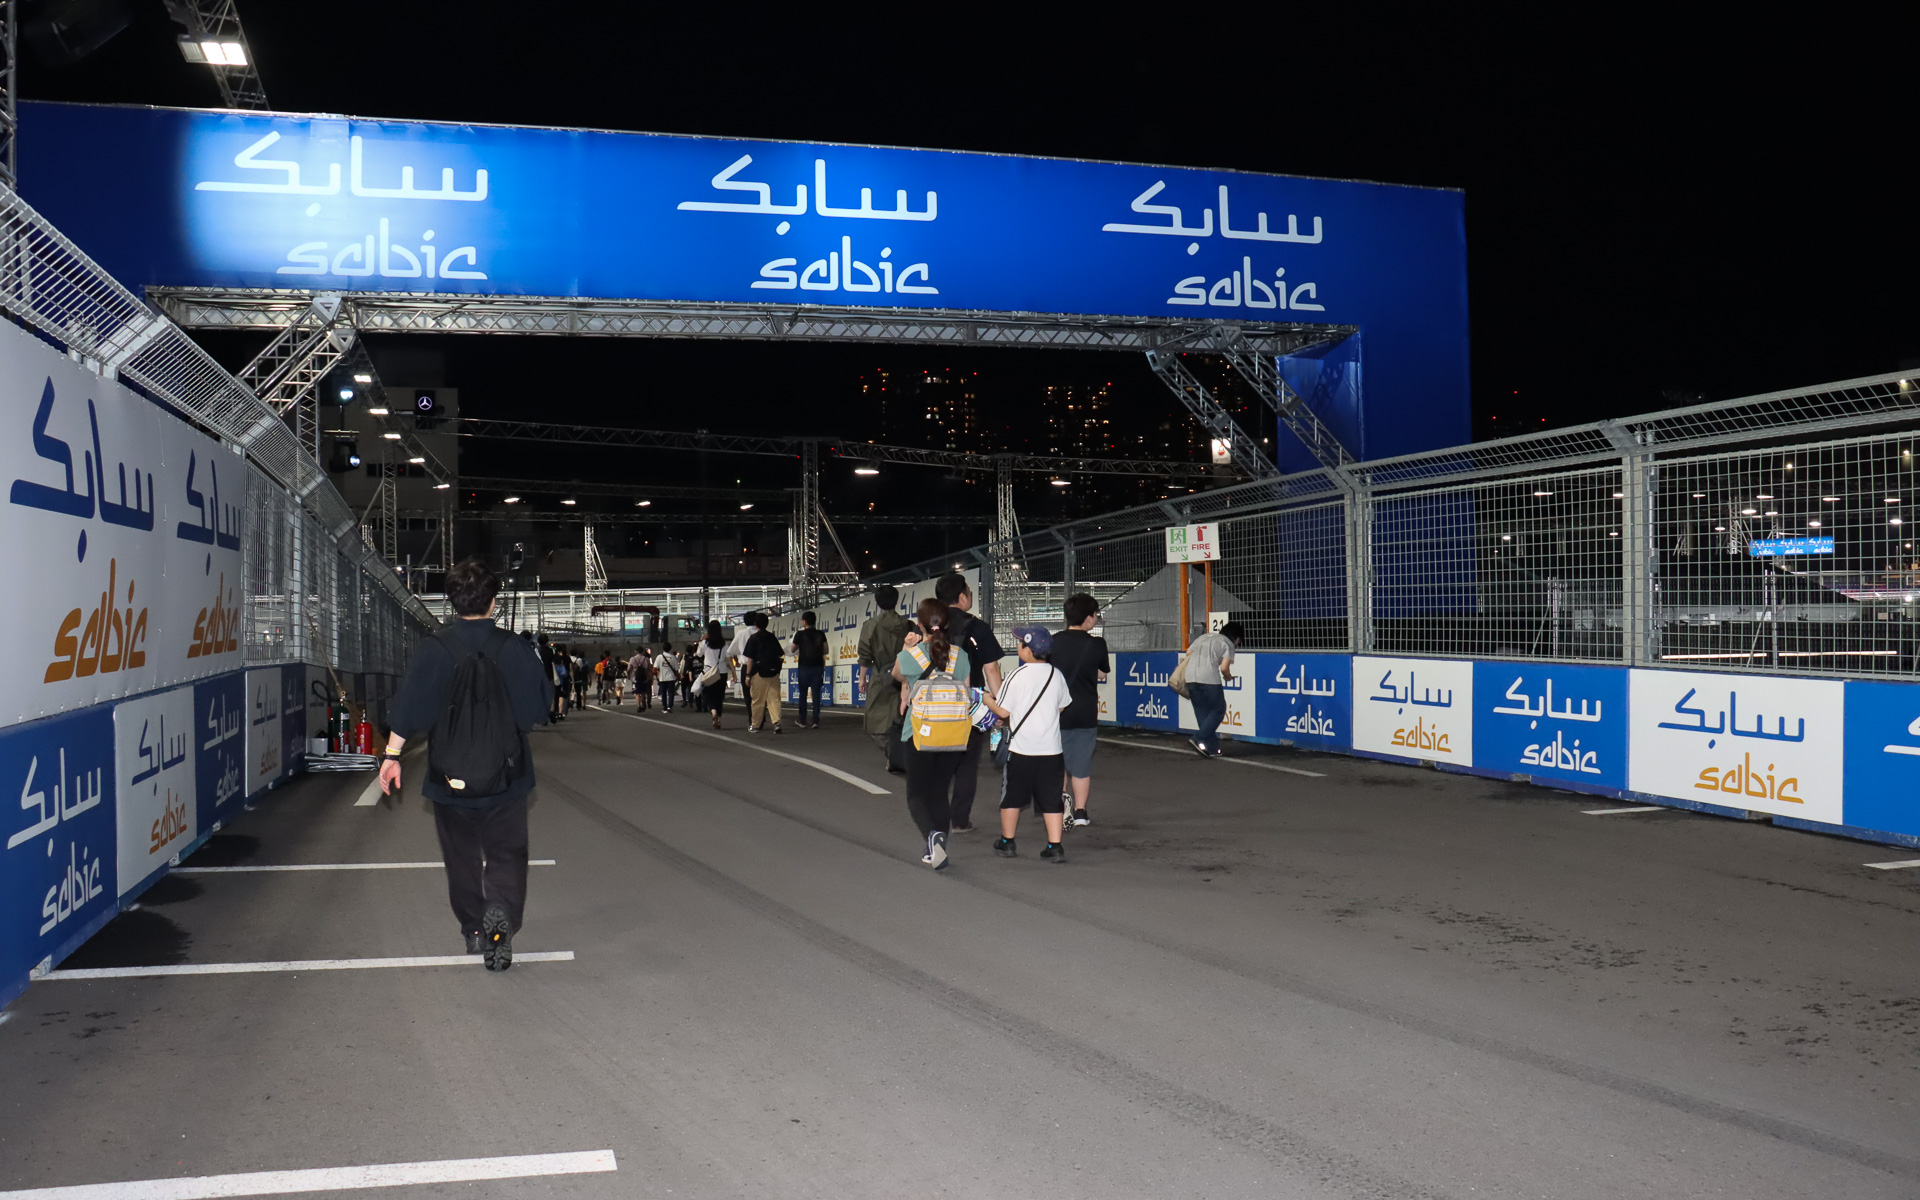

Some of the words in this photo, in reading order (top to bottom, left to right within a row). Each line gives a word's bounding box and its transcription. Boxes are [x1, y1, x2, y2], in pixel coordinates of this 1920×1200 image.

[195, 131, 488, 217] سابك
[677, 154, 938, 236] سابك
[1102, 180, 1323, 256] سابك
[276, 218, 488, 280] sabic
[750, 235, 939, 295] sabic
[1167, 256, 1326, 311] sabic
[44, 558, 148, 683] sabic
[187, 572, 238, 658] sabic
[1136, 694, 1169, 719] sabic
[1268, 664, 1335, 705] سابك
[1370, 669, 1452, 715] سابك
[1493, 676, 1601, 729] سابك
[1285, 704, 1335, 737] sabic
[1391, 716, 1452, 753] sabic
[1657, 687, 1805, 749] سابك
[216, 753, 239, 808] sabic
[1520, 730, 1601, 774] sabic
[1694, 752, 1805, 804] sabic
[7, 747, 101, 858] سابك
[149, 787, 187, 855] sabic
[40, 841, 103, 937] sabic
